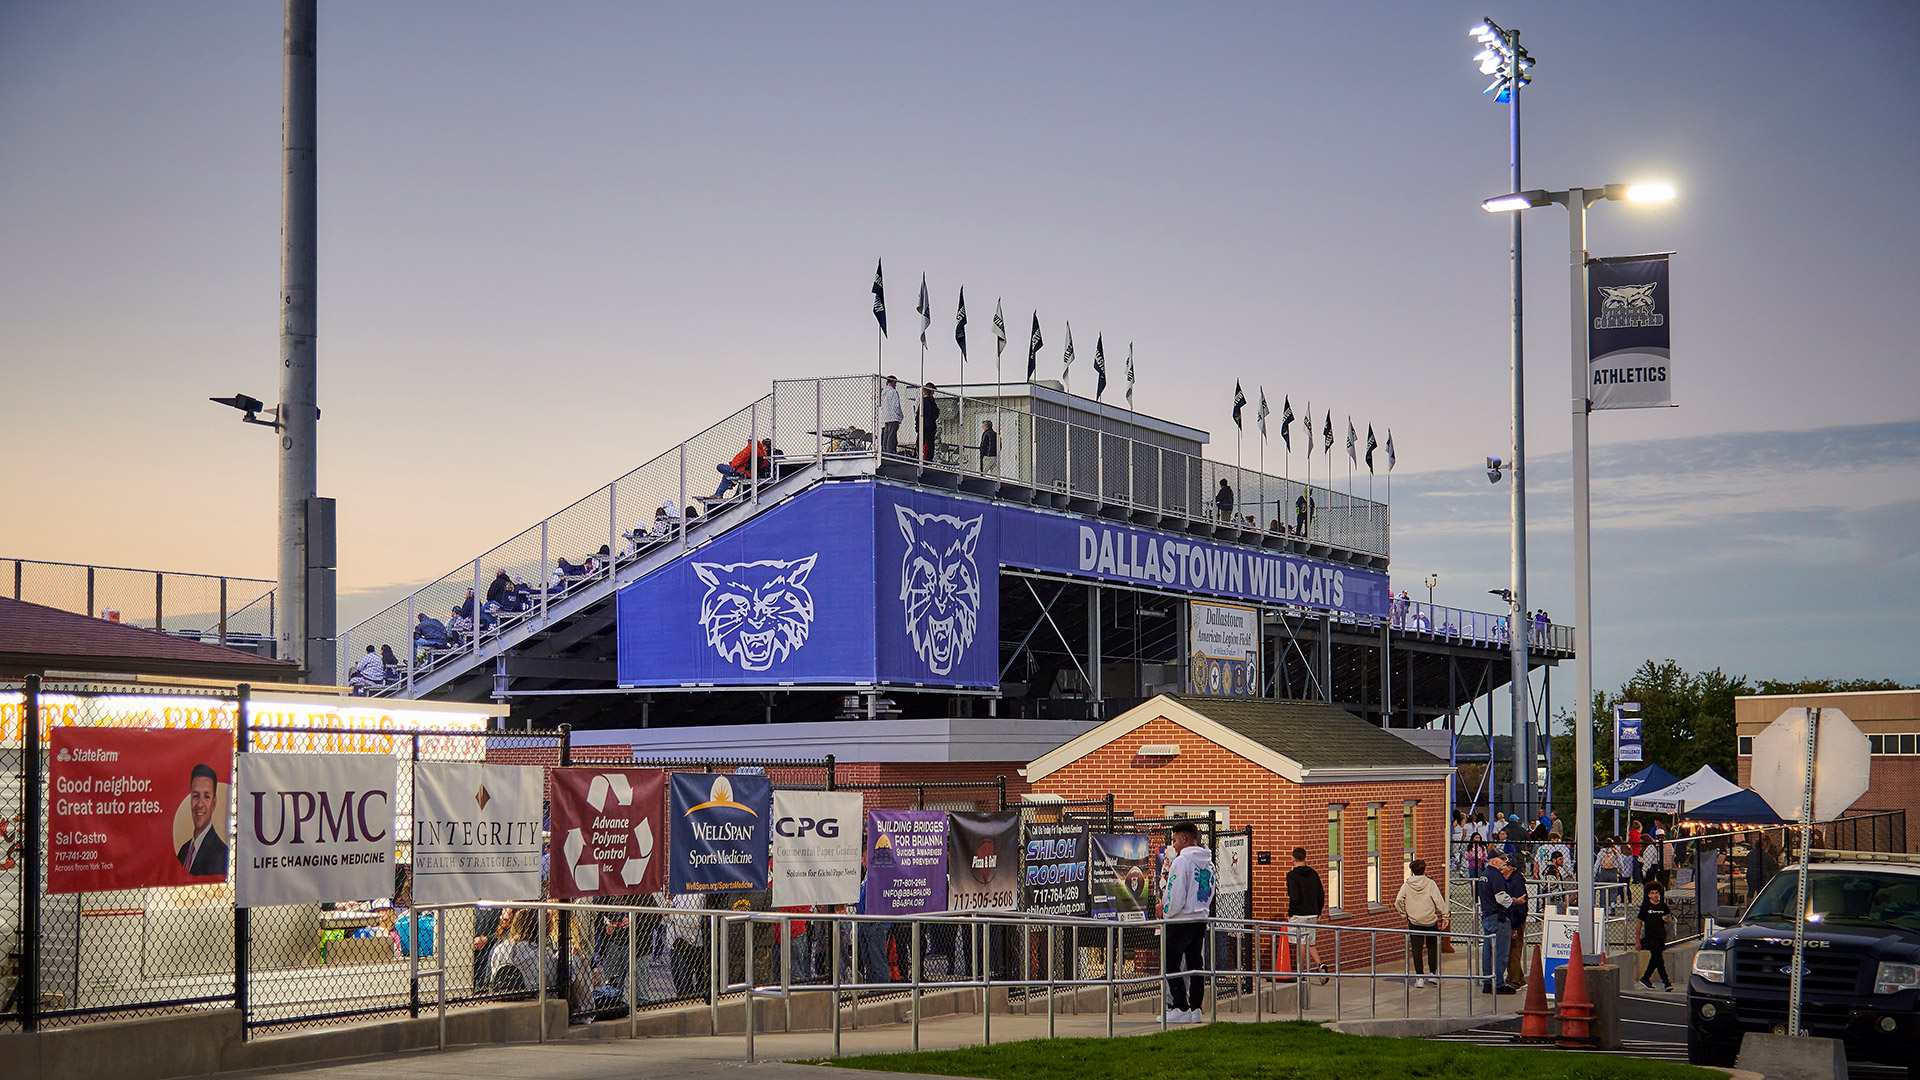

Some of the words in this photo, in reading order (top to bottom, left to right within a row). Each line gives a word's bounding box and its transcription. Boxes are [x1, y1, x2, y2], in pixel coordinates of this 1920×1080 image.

[1593, 366, 1666, 385] ATHLETICS
[1079, 525, 1243, 593] DALLASTOWN
[1248, 554, 1344, 608] WILDCATS
[1206, 607, 1244, 628] Dallastown
[1197, 629, 1222, 644] American
[1222, 631, 1239, 647] Legion
[1239, 632, 1251, 646] Field
[56, 776, 92, 794] Good
[95, 777, 153, 797] neighbor.
[56, 798, 94, 816] Great
[96, 800, 126, 815] auto
[128, 799, 163, 814] rates.
[250, 789, 388, 846] UPMC
[592, 815, 630, 829] Advance
[416, 821, 539, 846] INTEGRITY
[775, 817, 839, 838] CPG
[877, 821, 912, 832] BUILDING
[913, 821, 944, 833] BRIDGES
[55, 831, 74, 846] Sal
[74, 831, 108, 844] Castro
[591, 831, 629, 847] Polymer
[894, 835, 911, 847] FOR
[912, 835, 943, 847] BRIANNA
[55, 850, 98, 862] 717-741-2200
[593, 846, 627, 860] Control
[689, 849, 717, 868] Sports
[717, 848, 753, 864] Medicine
[896, 848, 916, 857] SUICIDE
[917, 847, 943, 857] AWARENESS
[1025, 838, 1077, 861] SHILOH
[54, 864, 75, 872] Across
[75, 863, 89, 871] from
[89, 863, 101, 871] York
[101, 862, 114, 870] Tech
[253, 856, 279, 869] LIFE
[281, 854, 338, 868] CHANGING
[341, 852, 385, 866] MEDICINE
[415, 856, 456, 868] WEALTH
[459, 855, 520, 868] STRATEGIES,
[524, 855, 539, 866] LLC
[603, 863, 613, 872] Inc.
[901, 858, 912, 866] AND
[912, 858, 939, 866] PREVENTION
[808, 869, 818, 877] for
[1025, 861, 1087, 886] ROOFING
[954, 891, 1014, 910] 717-506-5608
